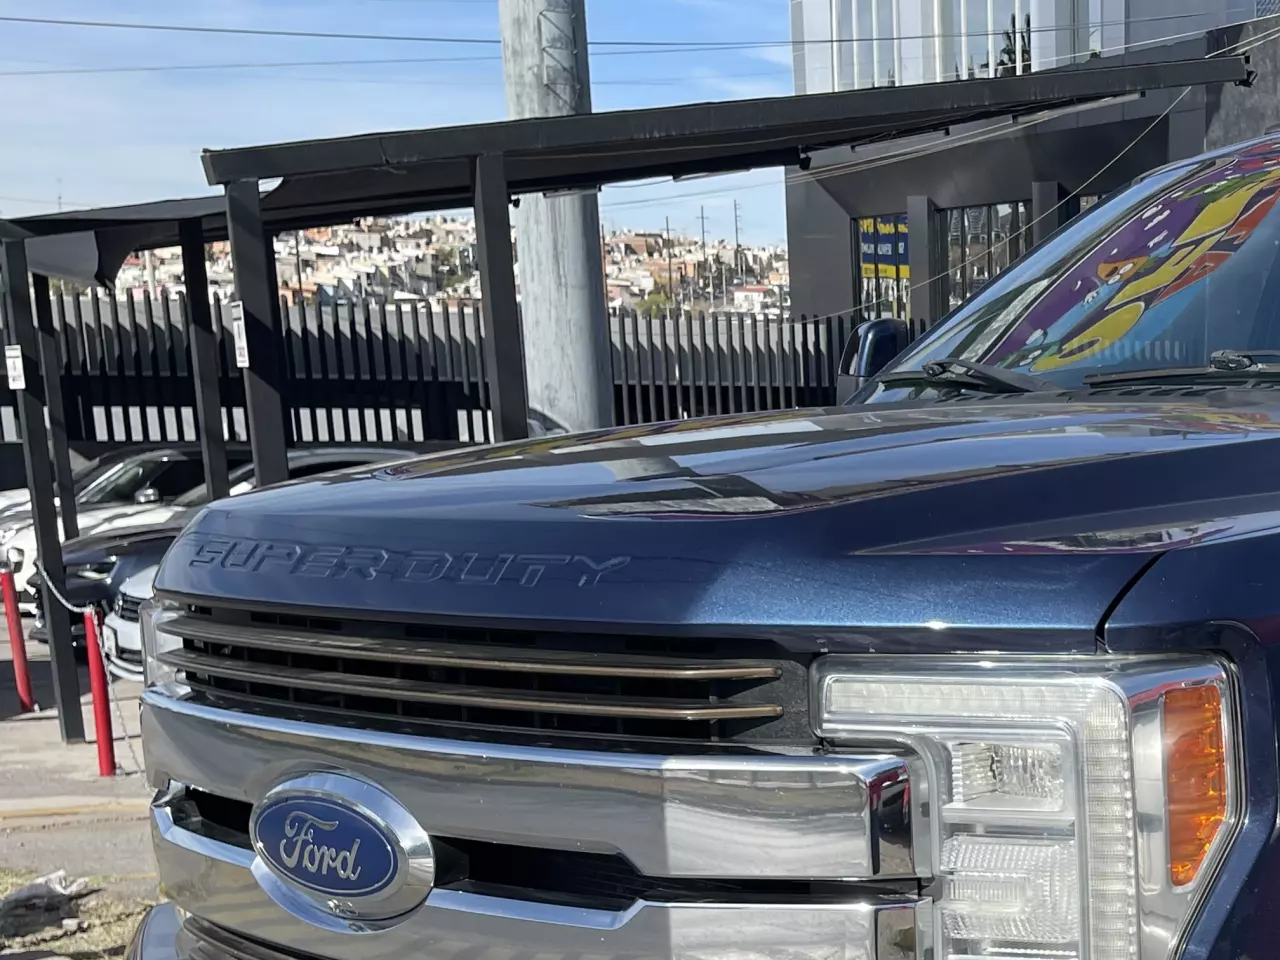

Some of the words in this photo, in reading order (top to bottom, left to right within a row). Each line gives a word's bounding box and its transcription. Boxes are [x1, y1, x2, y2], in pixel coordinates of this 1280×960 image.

[189, 538, 388, 580] SUPER
[402, 550, 631, 587] DUTY
[280, 811, 362, 881] Ford
